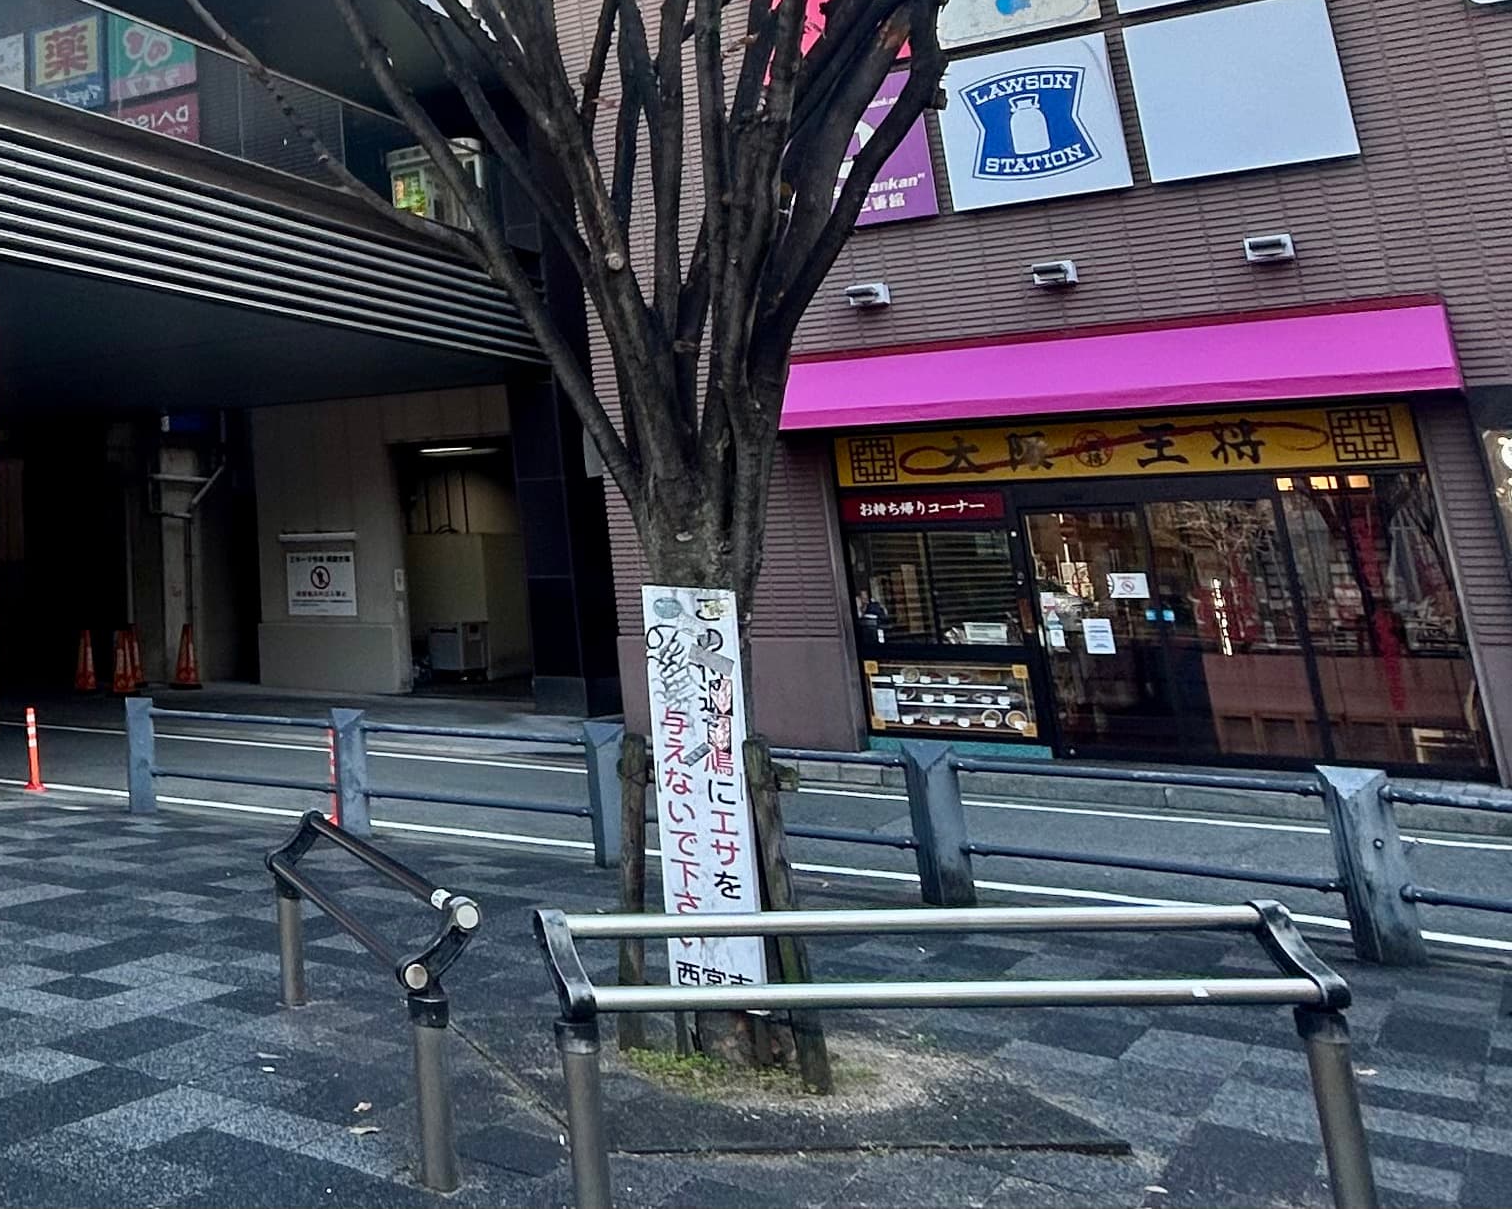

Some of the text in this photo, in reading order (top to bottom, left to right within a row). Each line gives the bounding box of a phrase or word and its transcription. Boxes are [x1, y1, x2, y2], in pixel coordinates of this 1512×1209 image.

[971, 74, 1073, 105] LAWSON
[985, 144, 1085, 173] STATION
[859, 499, 986, 518] お持ち帰りコーナー
